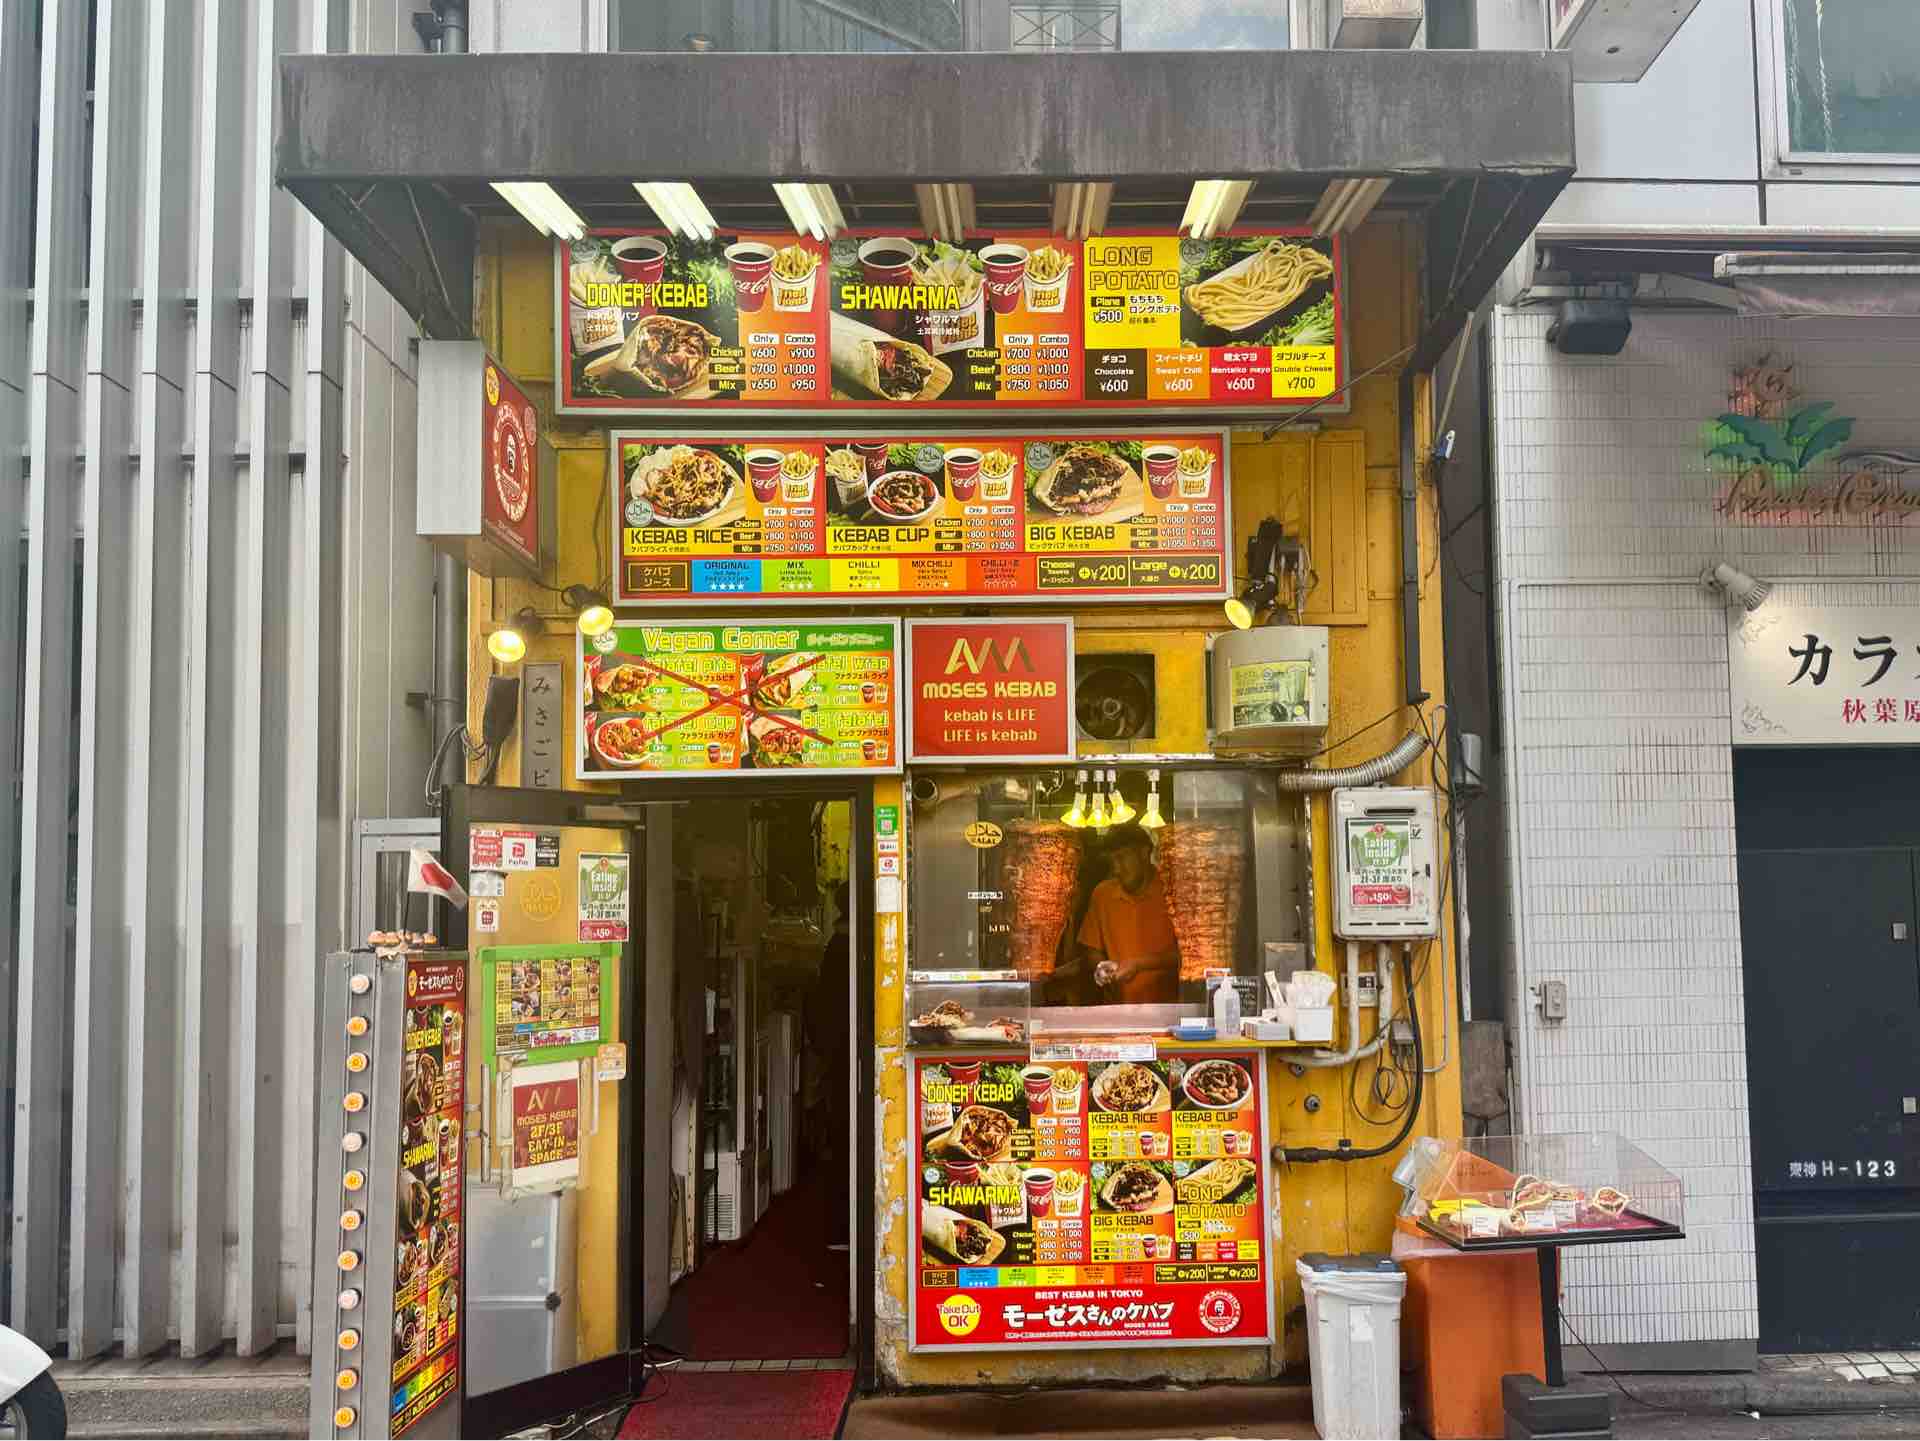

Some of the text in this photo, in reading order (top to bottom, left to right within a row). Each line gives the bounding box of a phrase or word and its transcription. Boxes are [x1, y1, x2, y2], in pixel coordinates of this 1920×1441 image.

[1089, 247, 1152, 266] LONG
[1089, 271, 1180, 290] POTATO
[587, 283, 643, 308] DONER
[652, 283, 707, 307] KEBAB
[841, 285, 960, 310] SHAWARMA
[915, 315, 960, 324] シャワルマ
[1094, 310, 1123, 323] ¥500
[753, 334, 815, 344] Only Combo
[1008, 336, 1069, 345] Only Combo
[711, 347, 815, 359] Chicken ¥600 ¥900
[967, 349, 999, 359] Chicken
[1006, 348, 1030, 359] ¥700
[1101, 354, 1127, 364] チョコ
[1276, 352, 1326, 361] ダブルチーズ
[715, 363, 740, 374] Beef
[752, 363, 777, 374] ¥700
[971, 365, 996, 375] Beef
[1006, 364, 1031, 375] ¥800
[1094, 367, 1134, 376] Chocolate
[1274, 365, 1332, 373] Double Cheese
[719, 379, 816, 390] Mix ¥650 ¥950
[974, 381, 992, 391] Mix
[1006, 379, 1031, 391] ¥750
[1100, 379, 1129, 392] ¥600
[1165, 378, 1193, 391] ¥600
[1226, 378, 1255, 390] ¥600
[1287, 377, 1315, 389] ¥700
[631, 529, 732, 544] KEBAB RICE
[833, 528, 929, 543] KEBAB CUP
[1030, 525, 1115, 541] BIG KEBAB
[704, 562, 748, 570] ORIGINAL
[848, 560, 880, 569] CHILLI
[911, 560, 925, 568] MIX
[1132, 559, 1167, 571] Large
[644, 578, 672, 587] ソース
[641, 628, 715, 653] Vegan
[722, 628, 799, 650] Corner
[1787, 633, 1920, 688] カラ
[923, 681, 1057, 699] MOSES KEBAB
[944, 708, 1036, 722] kebab is LIFE
[944, 729, 1037, 742] LIFE is kebab
[1364, 836, 1397, 850] Eating
[927, 1084, 1014, 1103] DONER KEBAB
[1092, 1112, 1158, 1124] KEBAB RICE
[1175, 1112, 1238, 1122] KEBAB CUP
[530, 1121, 563, 1138] 2F/3F
[529, 1150, 563, 1164] SPACE
[929, 1186, 1021, 1206] SHAWARMA
[1176, 1184, 1223, 1201] LONG
[1177, 1204, 1246, 1218] POTATO
[1094, 1215, 1153, 1226] BIG KEBAB
[1035, 1289, 1144, 1300] BEST KEBAB IN TOKYO
[949, 1315, 968, 1327] OK
[1003, 1302, 1174, 1328] モーゼスさんのケバブ
